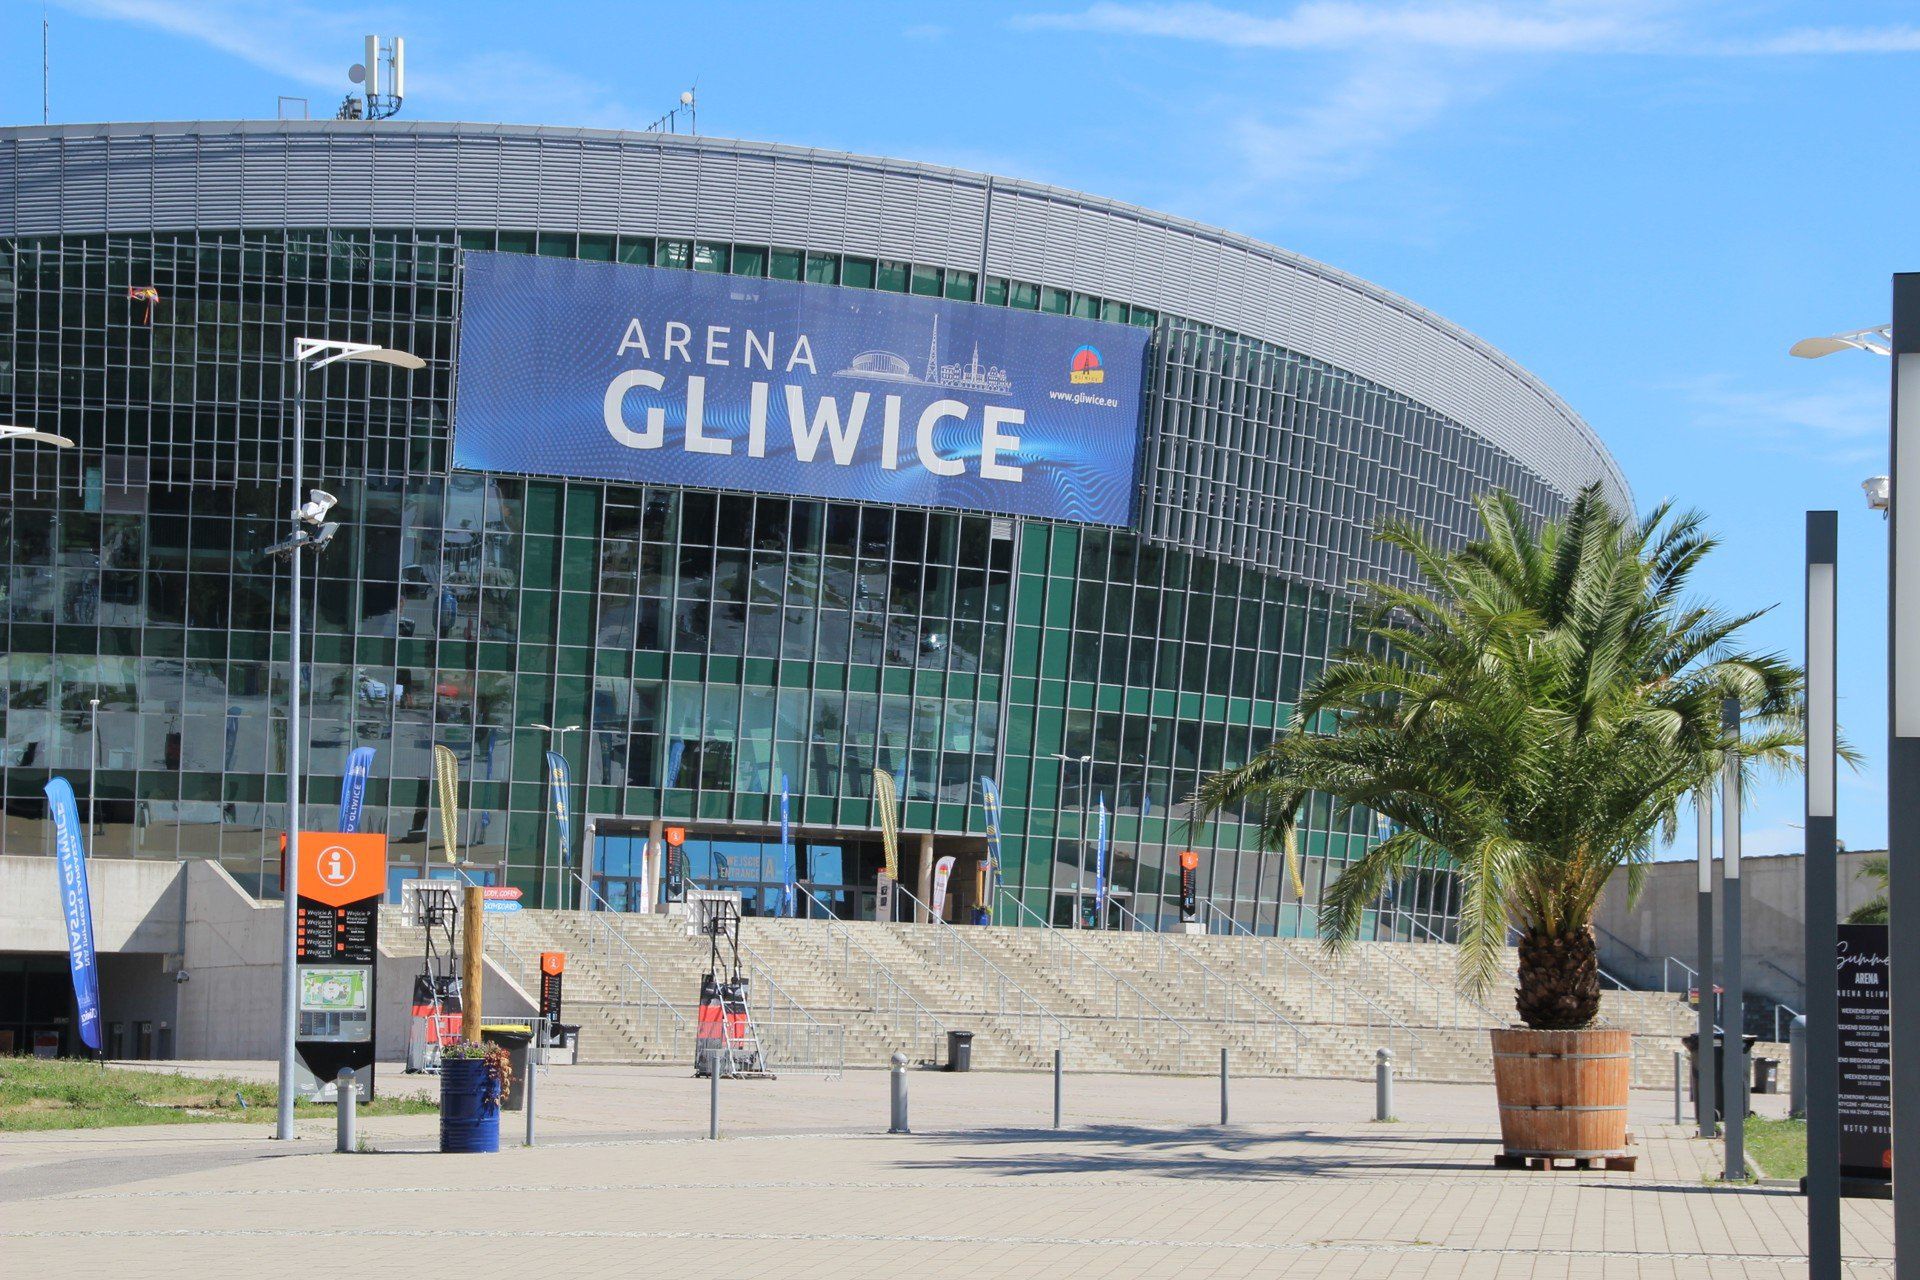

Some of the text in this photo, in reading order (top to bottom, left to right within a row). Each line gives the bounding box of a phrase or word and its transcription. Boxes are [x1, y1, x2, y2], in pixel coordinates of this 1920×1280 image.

[616, 317, 818, 376] ARENA
[1049, 390, 1118, 407] www.gliwice.eu
[602, 367, 1027, 482] GLIWICE
[350, 784, 361, 821] GLIWICE
[764, 857, 776, 880] A
[1855, 972, 1879, 985] ARENA
